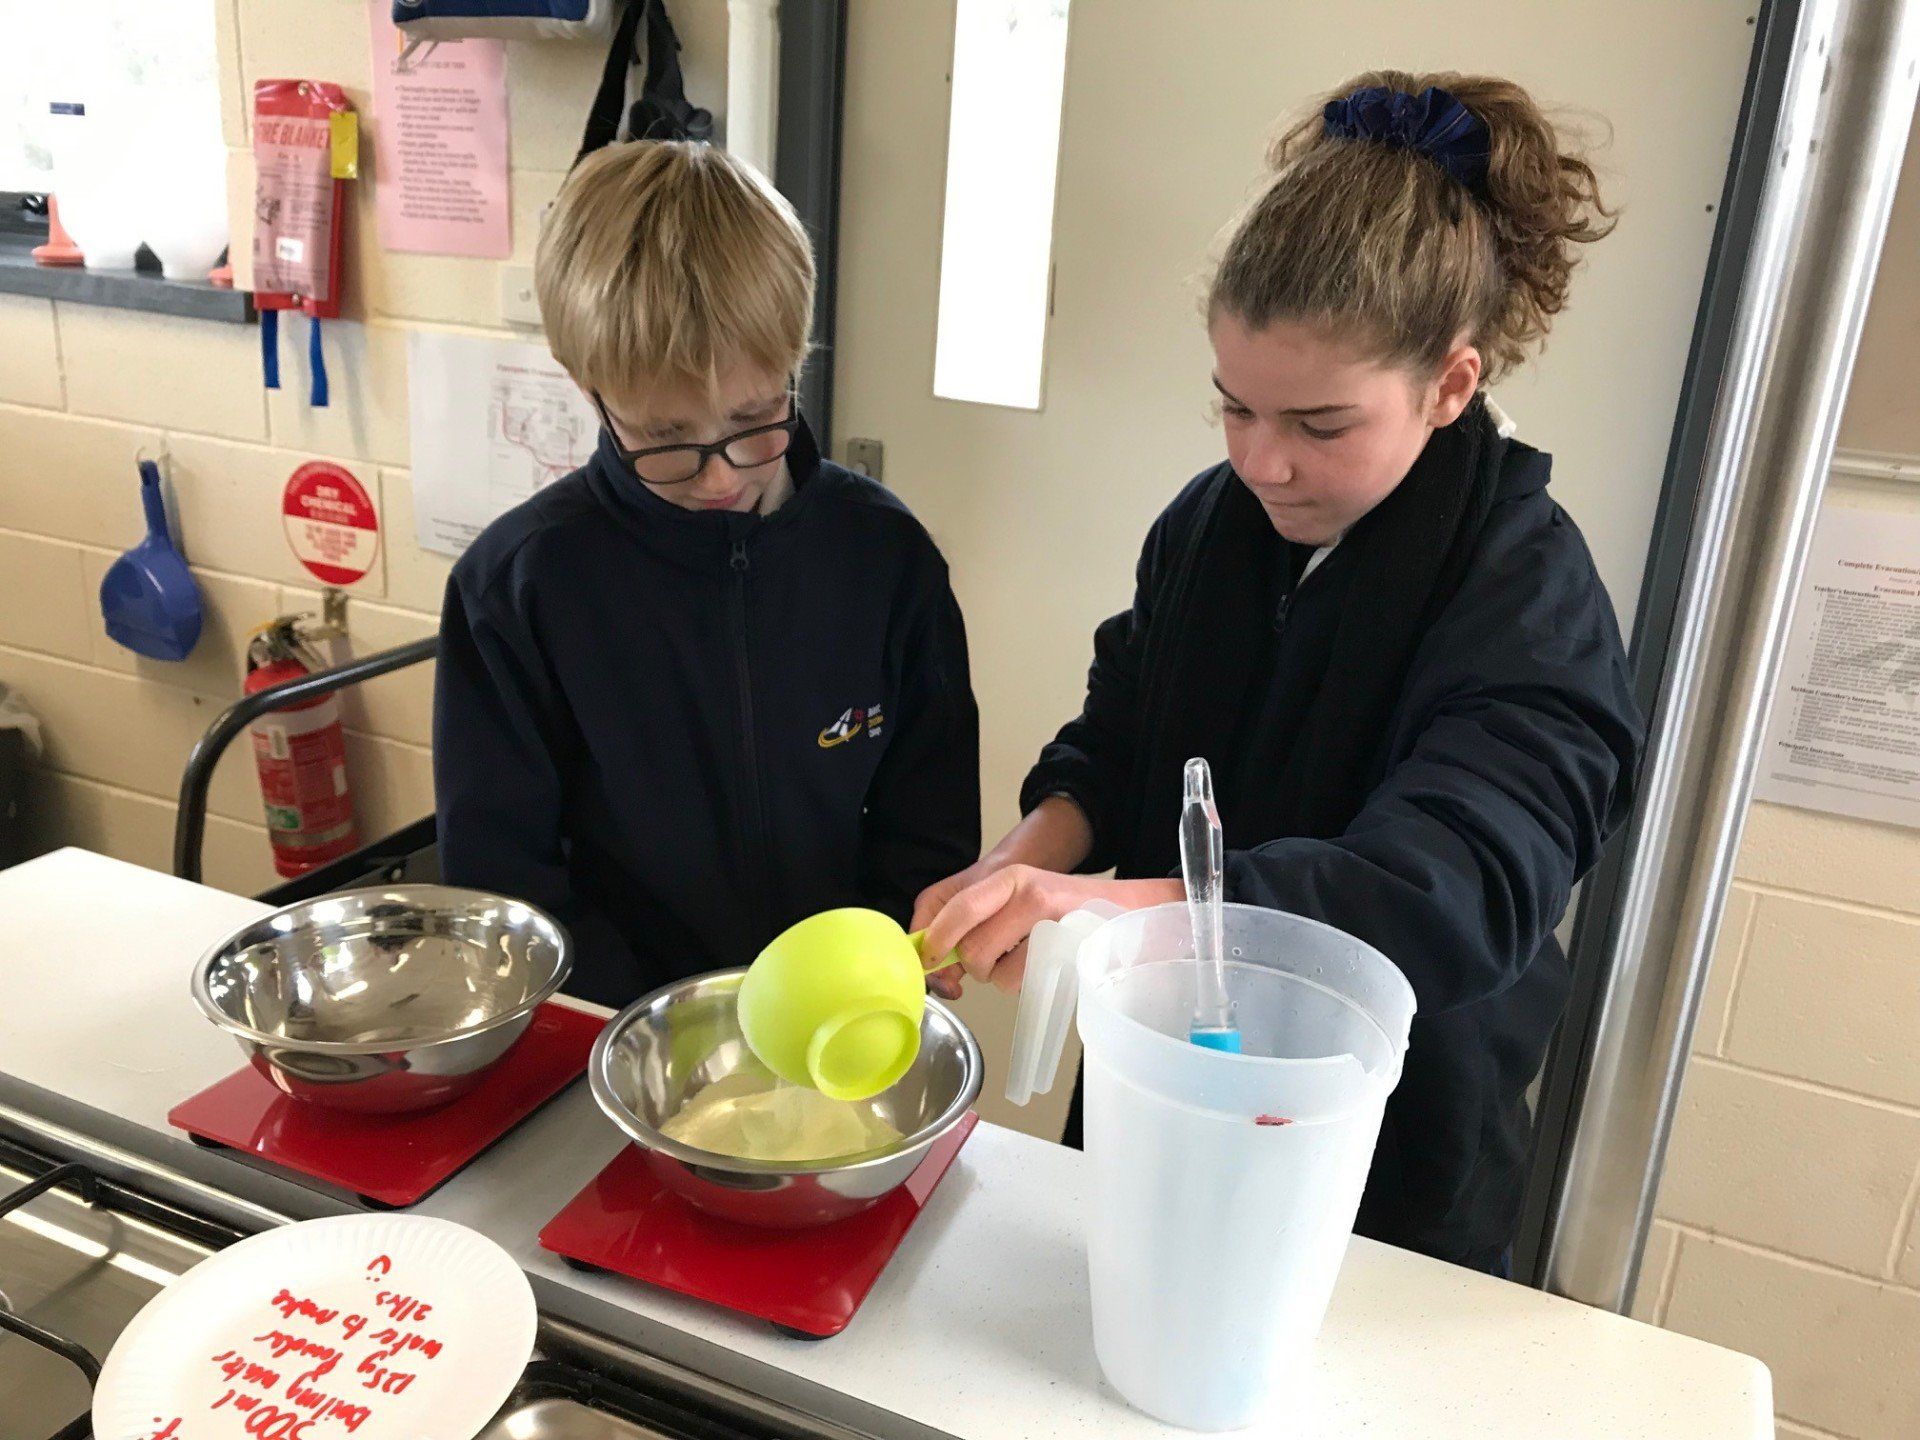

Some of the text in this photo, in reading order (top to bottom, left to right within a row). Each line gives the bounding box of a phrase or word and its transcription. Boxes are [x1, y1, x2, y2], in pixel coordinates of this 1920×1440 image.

[1837, 559, 1874, 571] Complete
[342, 1314, 369, 1341] to
[368, 1327, 443, 1360] water
[210, 1350, 281, 1389] water
